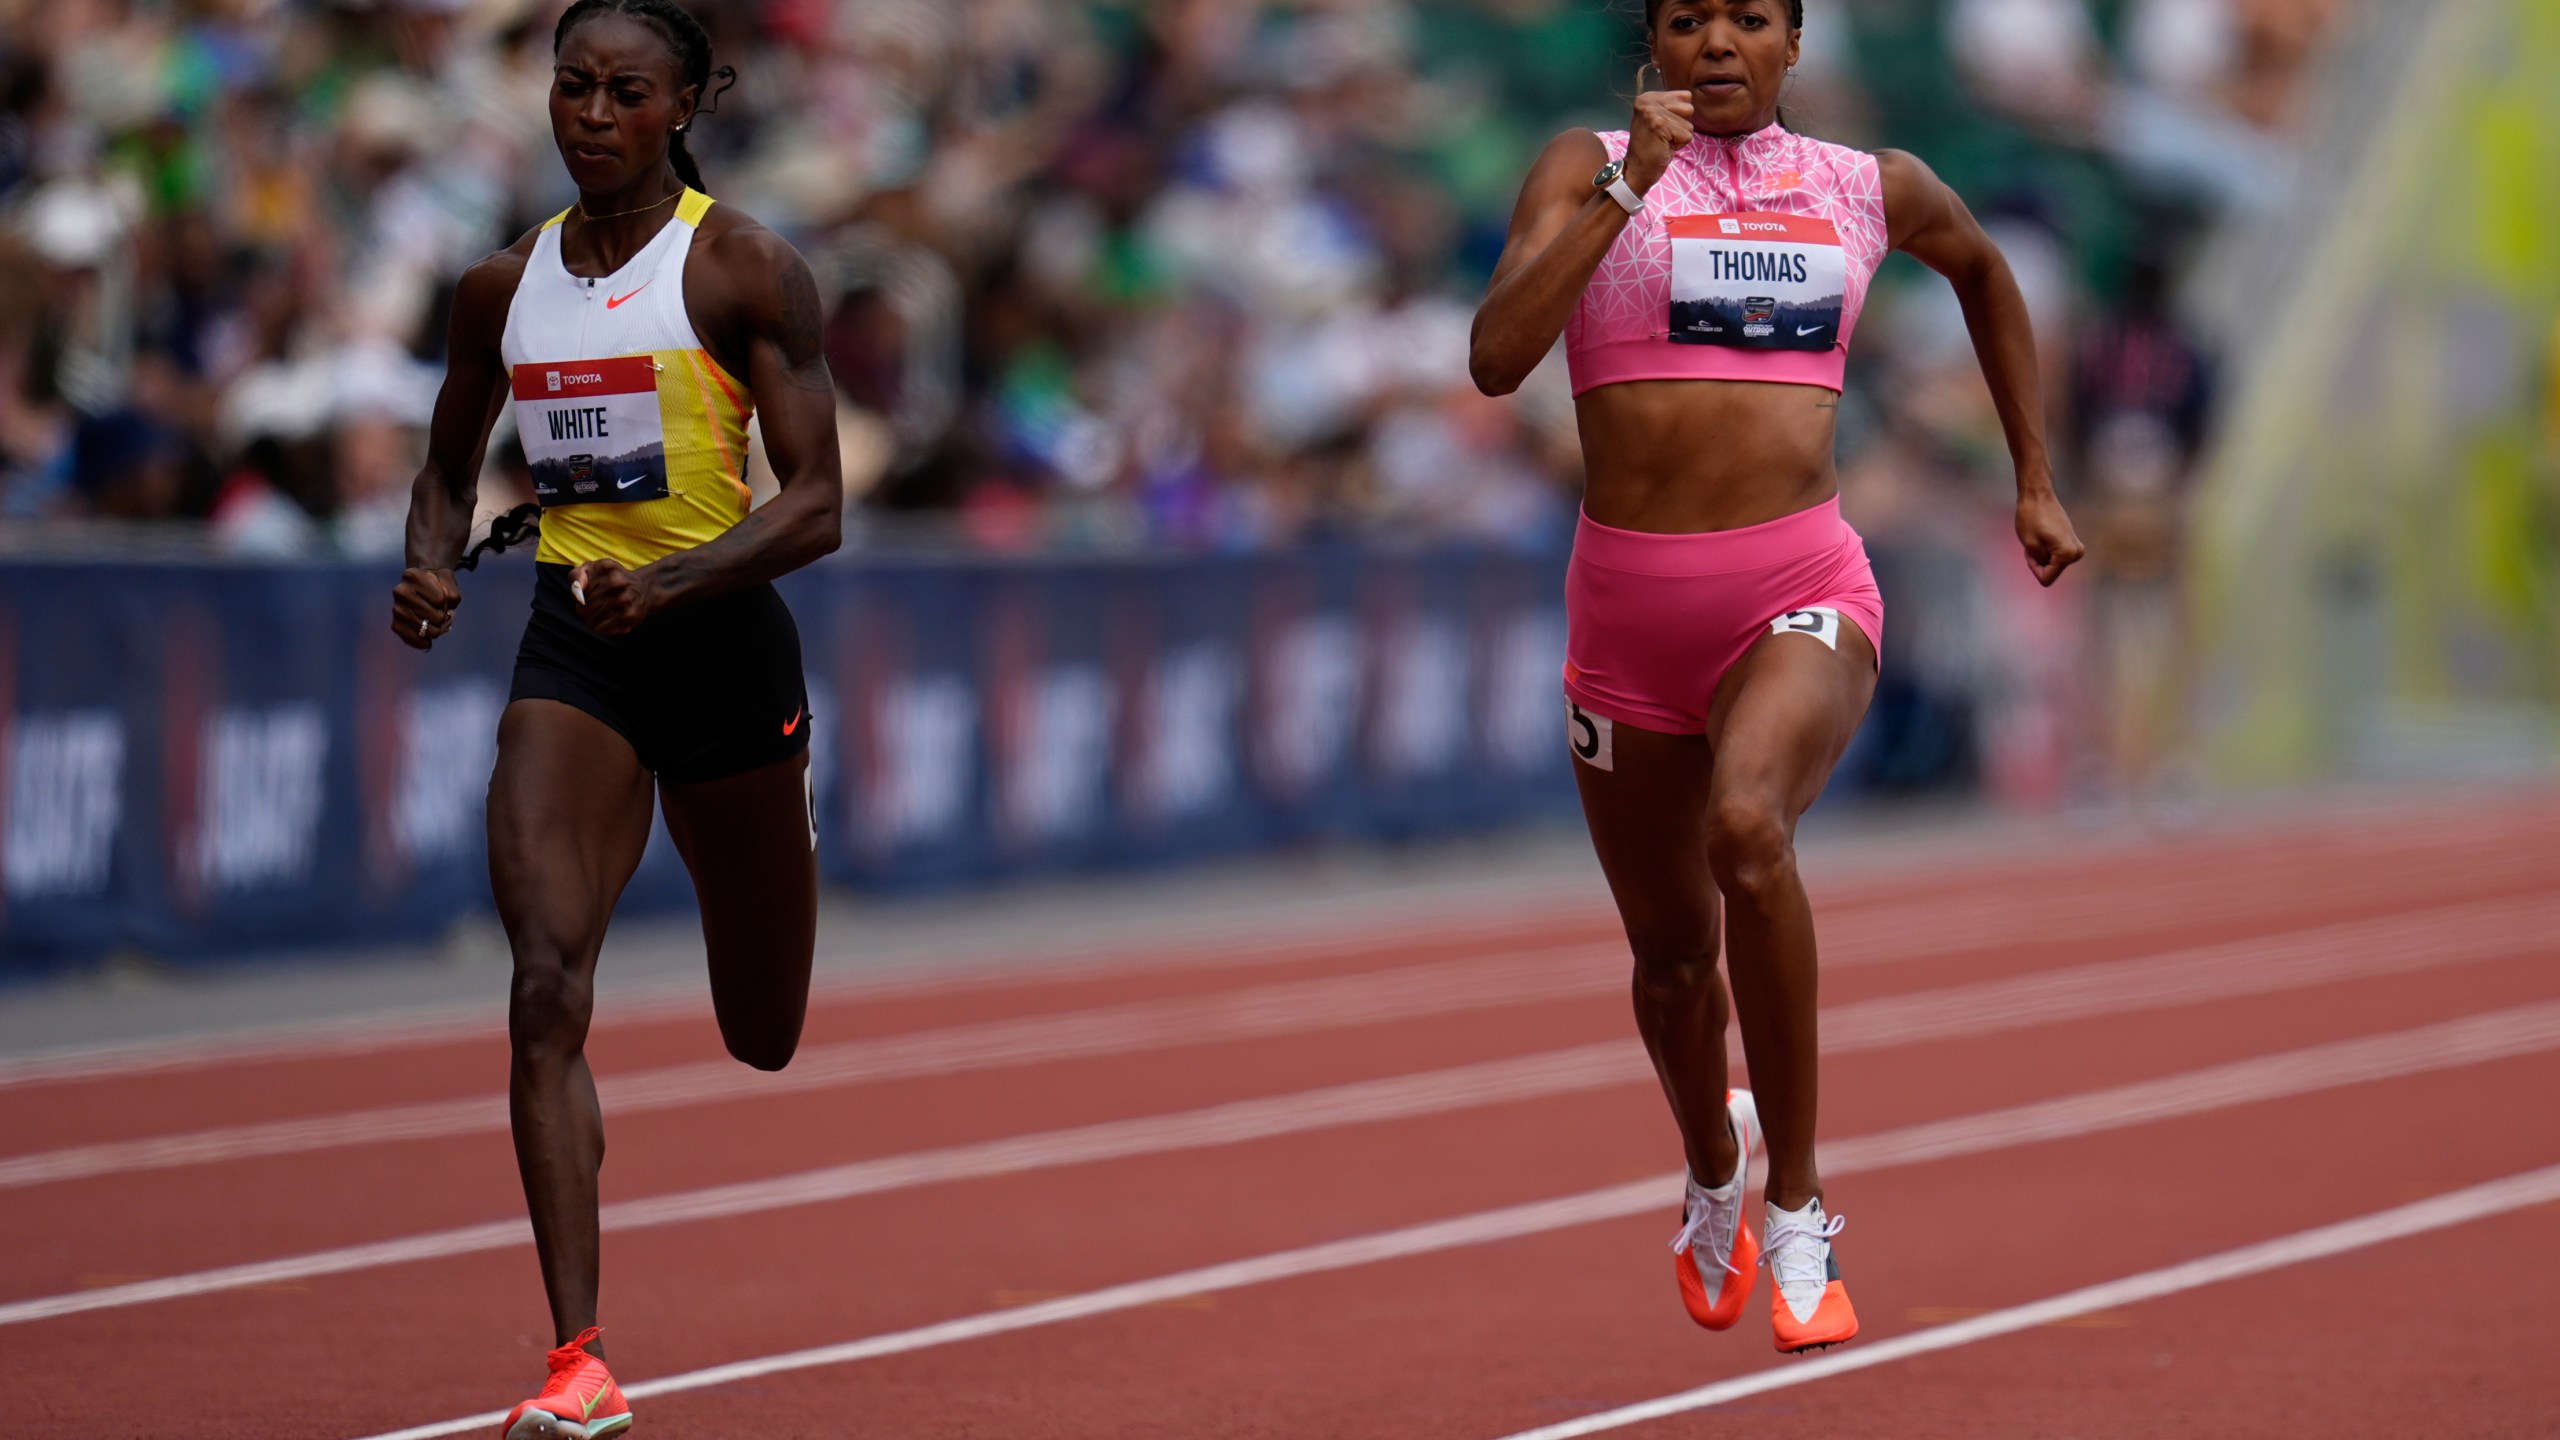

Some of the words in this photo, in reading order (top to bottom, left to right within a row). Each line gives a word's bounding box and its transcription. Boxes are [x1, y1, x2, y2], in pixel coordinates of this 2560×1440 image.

[1741, 222, 1787, 233] TOYOTA
[1709, 250, 1807, 283] THOMAS
[562, 373, 602, 385] TOYOTA
[547, 406, 609, 441] WHITE
[1572, 703, 1599, 760] 5
